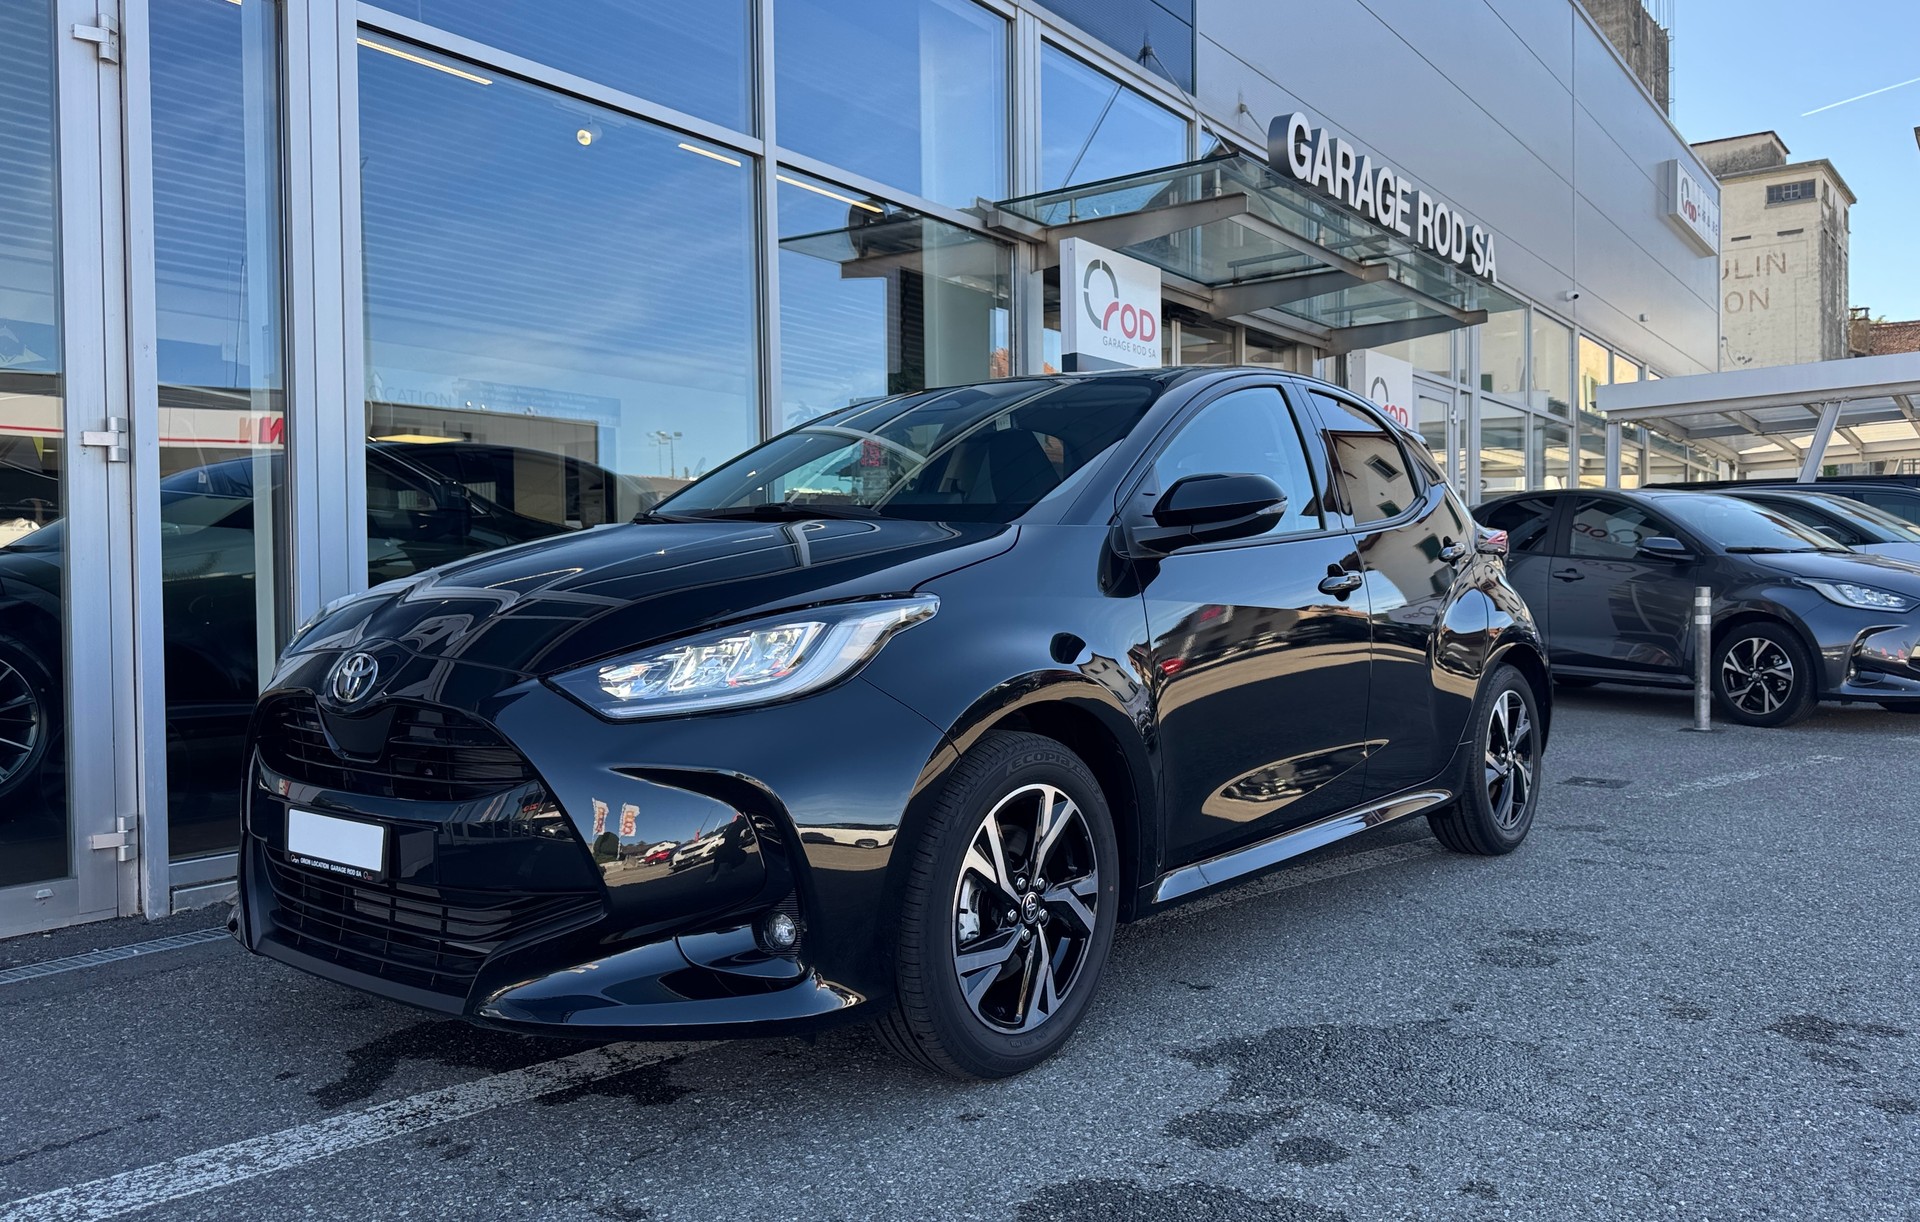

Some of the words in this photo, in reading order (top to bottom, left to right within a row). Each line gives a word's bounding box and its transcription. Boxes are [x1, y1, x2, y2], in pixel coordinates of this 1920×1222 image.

[1286, 111, 1412, 238] GARAGE
[1417, 190, 1467, 265] ROD
[1471, 224, 1498, 284] SA
[1102, 336, 1131, 352] GARAGE
[1132, 344, 1147, 356] ROD
[1148, 348, 1157, 359] SA
[1383, 404, 1408, 428] OD
[311, 859, 330, 870] LOCATION
[330, 864, 347, 874] GARAGE
[347, 868, 356, 876] ROD
